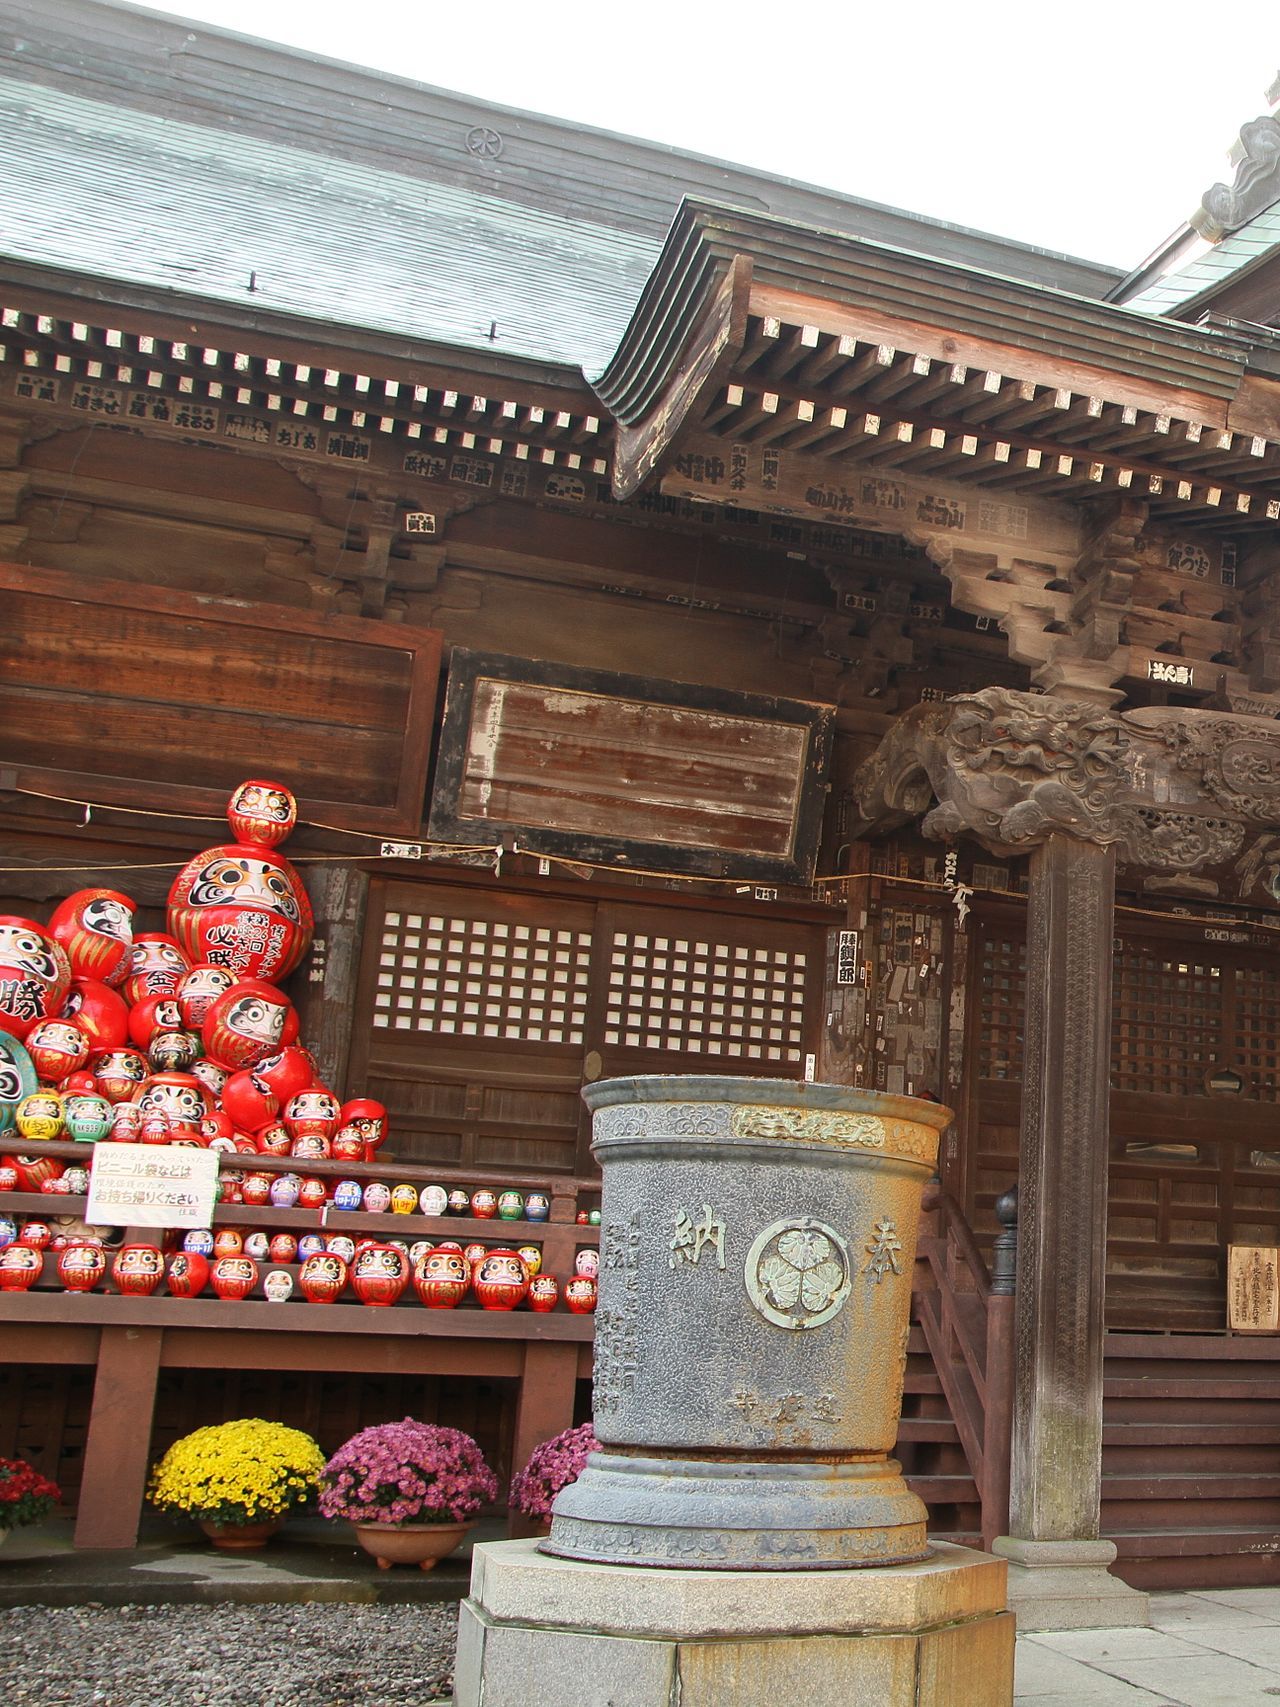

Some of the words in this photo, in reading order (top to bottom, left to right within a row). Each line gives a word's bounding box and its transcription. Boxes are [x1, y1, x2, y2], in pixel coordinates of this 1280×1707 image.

[206, 925, 236, 967] 必勝
[0, 979, 48, 1022] 勝
[97, 1161, 192, 1178] ビニール袋などは
[95, 1189, 200, 1205] お持ち帰りください
[668, 1203, 728, 1271] 納
[861, 1214, 902, 1283] 奉
